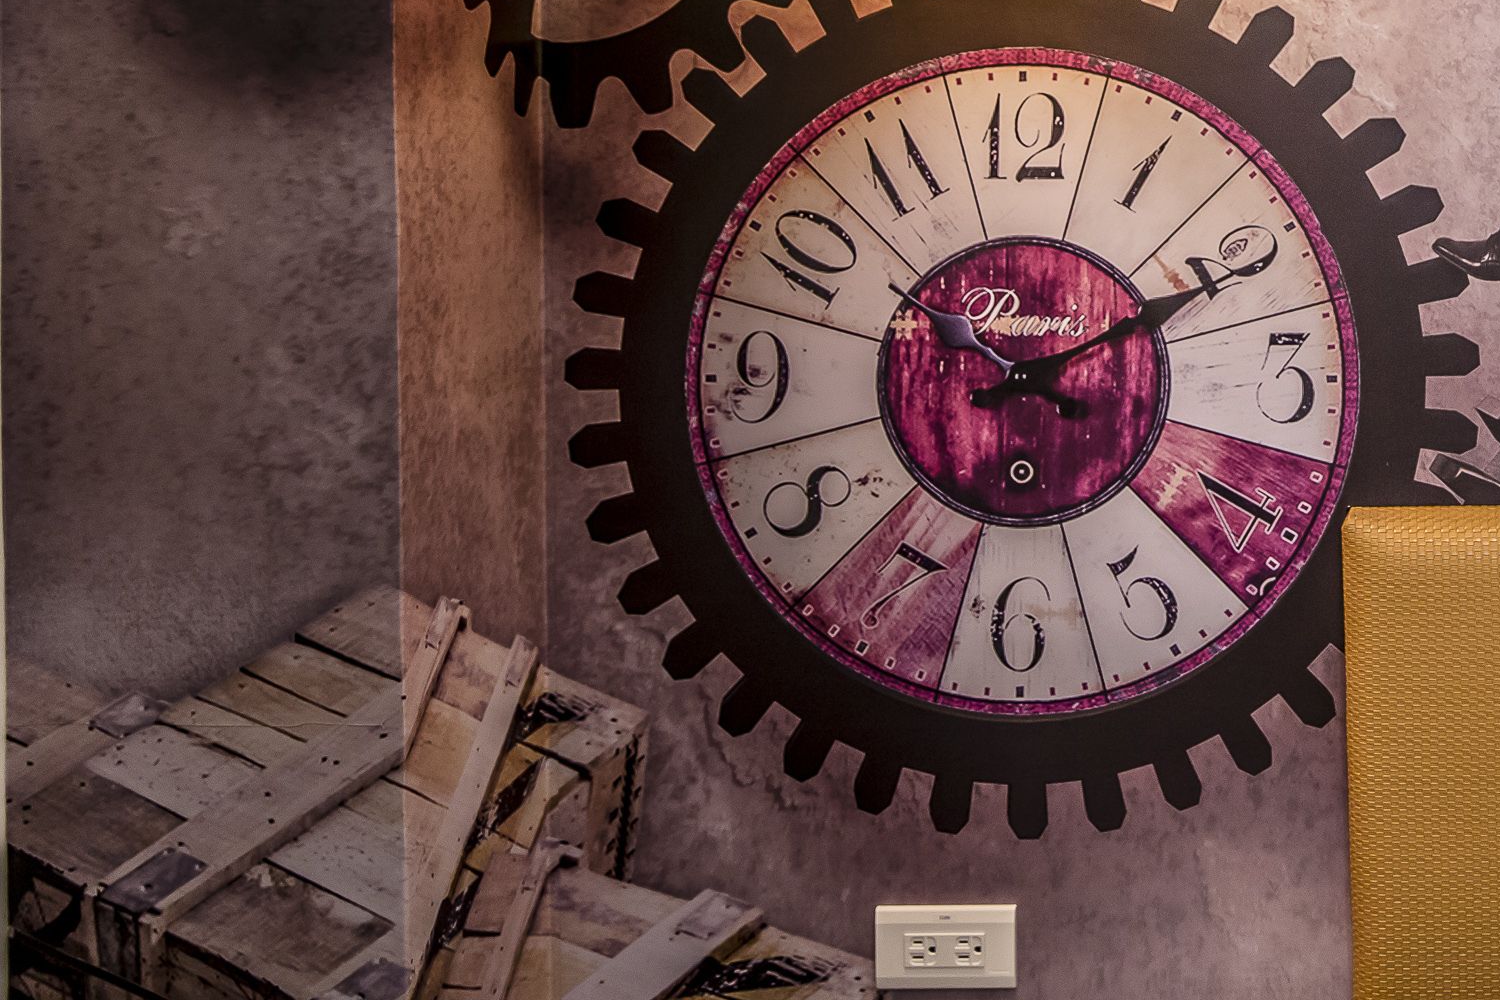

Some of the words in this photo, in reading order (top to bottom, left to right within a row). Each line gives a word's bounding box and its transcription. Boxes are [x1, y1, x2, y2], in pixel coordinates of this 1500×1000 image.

[863, 117, 951, 222] 11
[983, 92, 1066, 183] 12
[1113, 135, 1173, 213] 1
[760, 208, 859, 310] 10
[1184, 224, 1279, 300] 2
[731, 331, 791, 424] 9
[1256, 332, 1316, 425] 3
[762, 464, 852, 539] 8
[1196, 469, 1286, 553] 4
[863, 541, 951, 630] 7
[990, 576, 1053, 673] 6
[1106, 544, 1180, 642] 5
